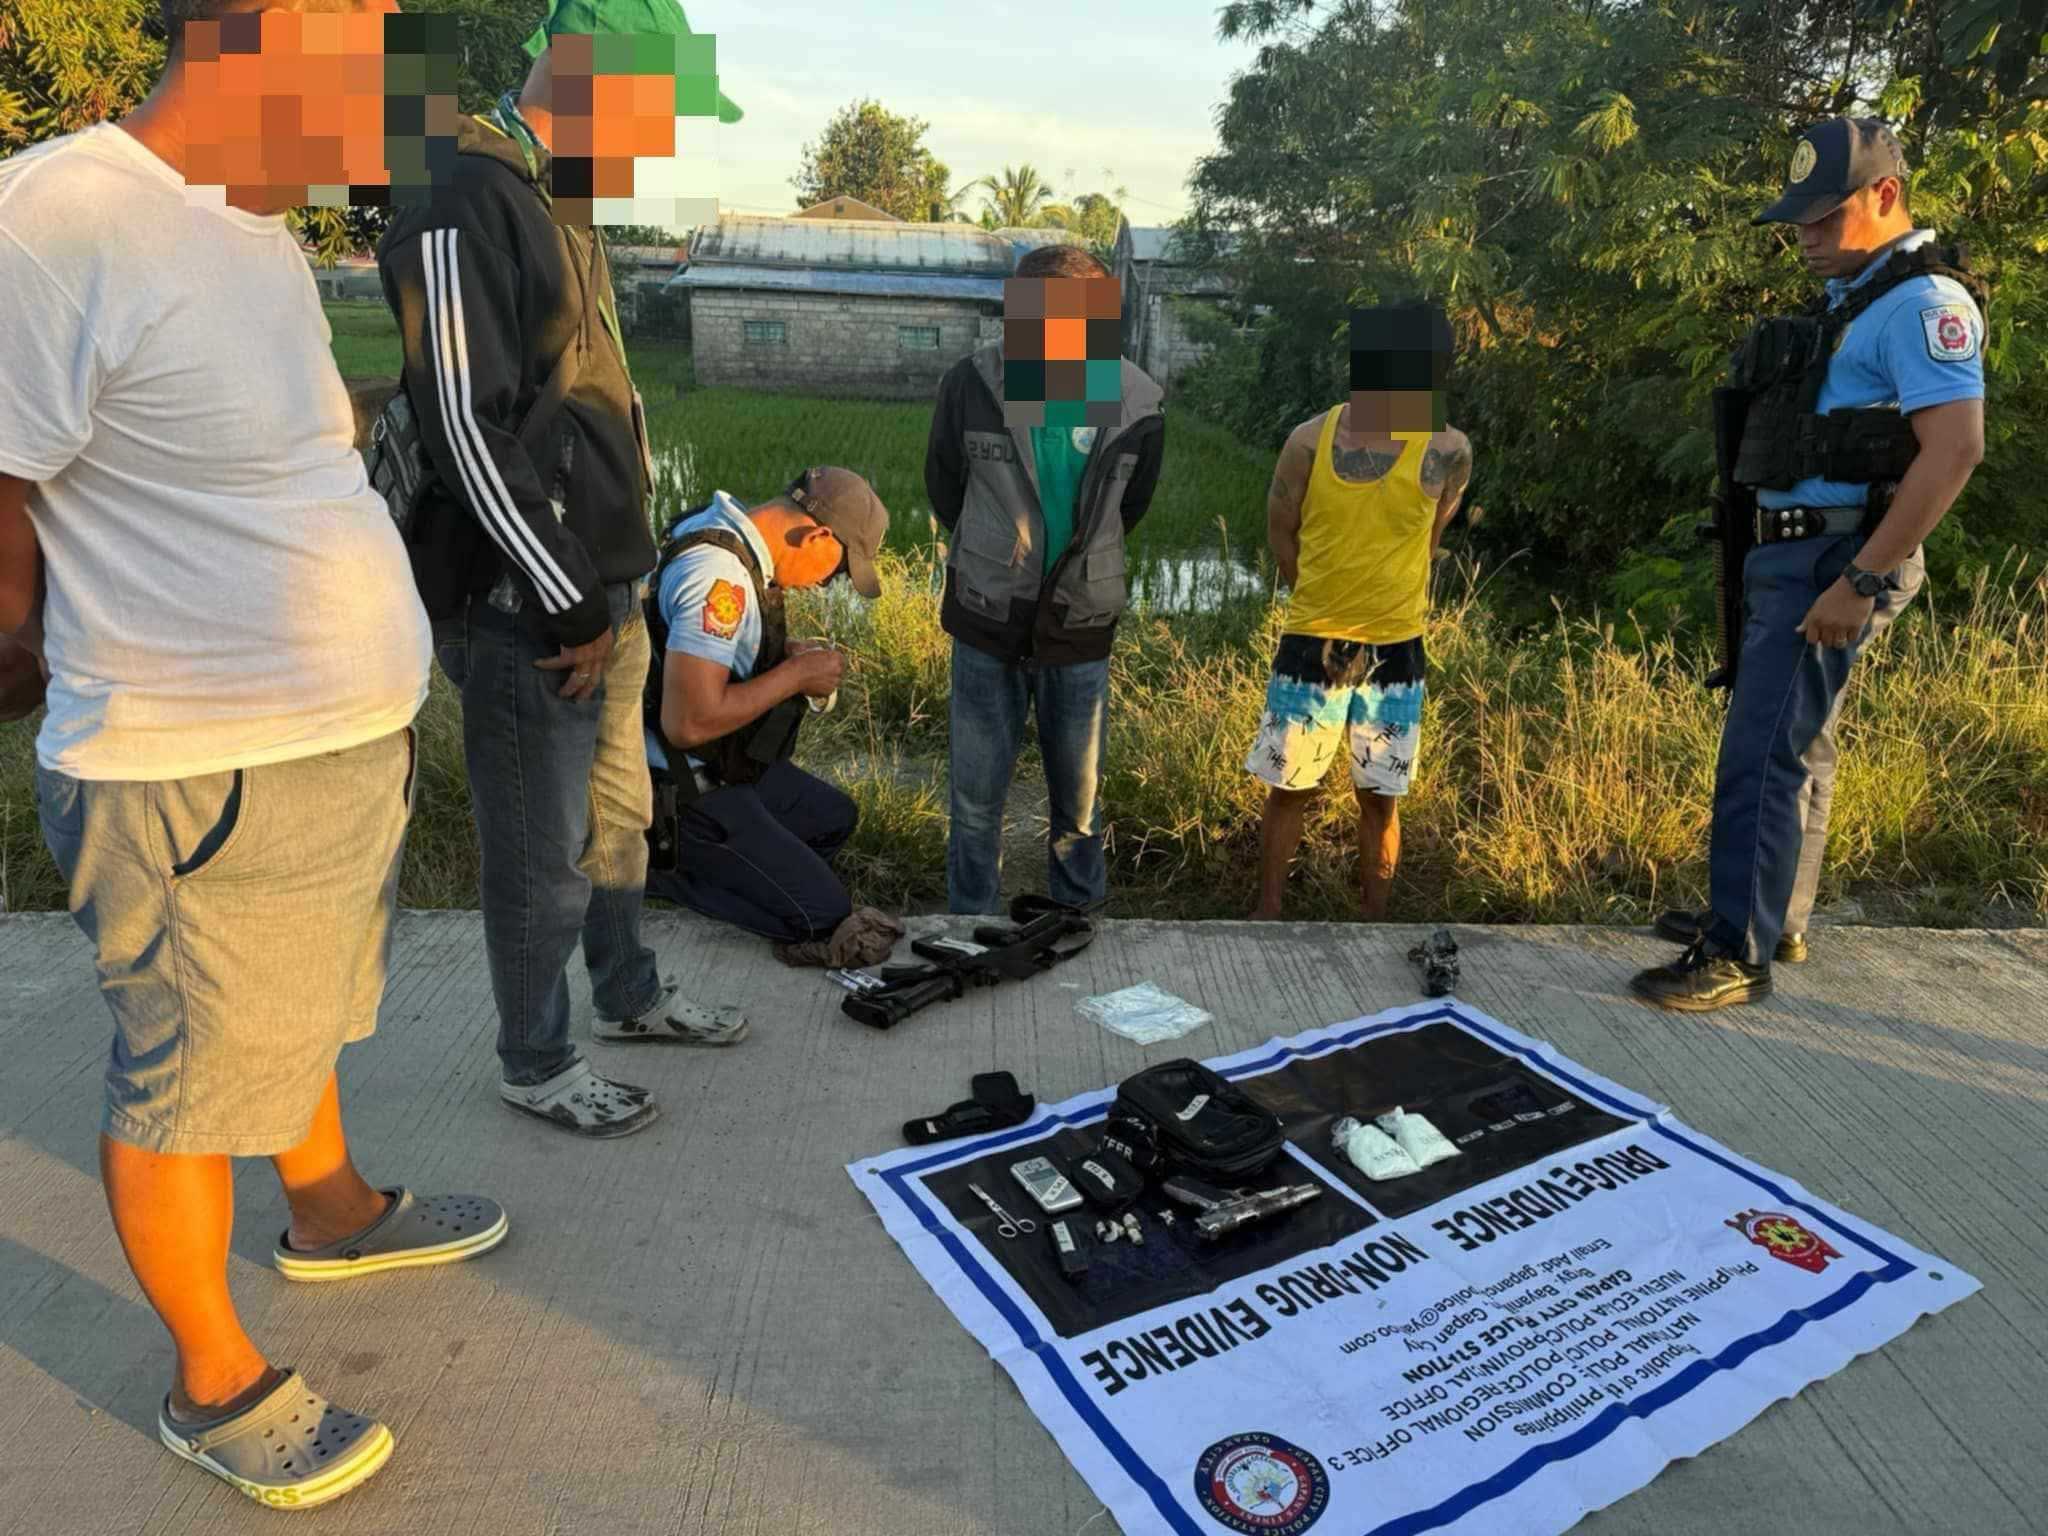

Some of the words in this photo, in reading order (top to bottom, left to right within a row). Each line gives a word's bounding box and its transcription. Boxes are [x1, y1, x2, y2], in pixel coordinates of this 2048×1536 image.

[1574, 1144, 1671, 1191] DRUG
[1431, 1166, 1594, 1251] EVIDENCE
[1536, 1253, 1572, 1273] Add:
[1569, 1238, 1613, 1261] Email
[1256, 1231, 1430, 1317] NON-DRUG
[1574, 1269, 1632, 1301] GAPAN
[1489, 1284, 1559, 1314] Bayanihn,
[1537, 1298, 1579, 1322] CITY
[1435, 1307, 1488, 1346] Gapan
[1477, 1316, 1539, 1347] PLICE
[1543, 1312, 1596, 1341] POLIC
[1622, 1311, 1701, 1355] NATNAL
[1080, 1297, 1273, 1397] EVIDENCE
[1403, 1338, 1437, 1352] Cty
[1635, 1343, 1699, 1379] Rpublic
[1497, 1345, 1564, 1396] POLICE
[1571, 1350, 1629, 1381] POLI
[1599, 1383, 1622, 1399] th
[1618, 1375, 1637, 1394] of
[1380, 1384, 1449, 1426] OFFICE
[1408, 1381, 1501, 1434] REGIONAL
[1513, 1378, 1605, 1436] Philippines
[1342, 1424, 1412, 1466] OFFICE
[1327, 1456, 1345, 1471] 3
[223, 1472, 301, 1505] ocs
